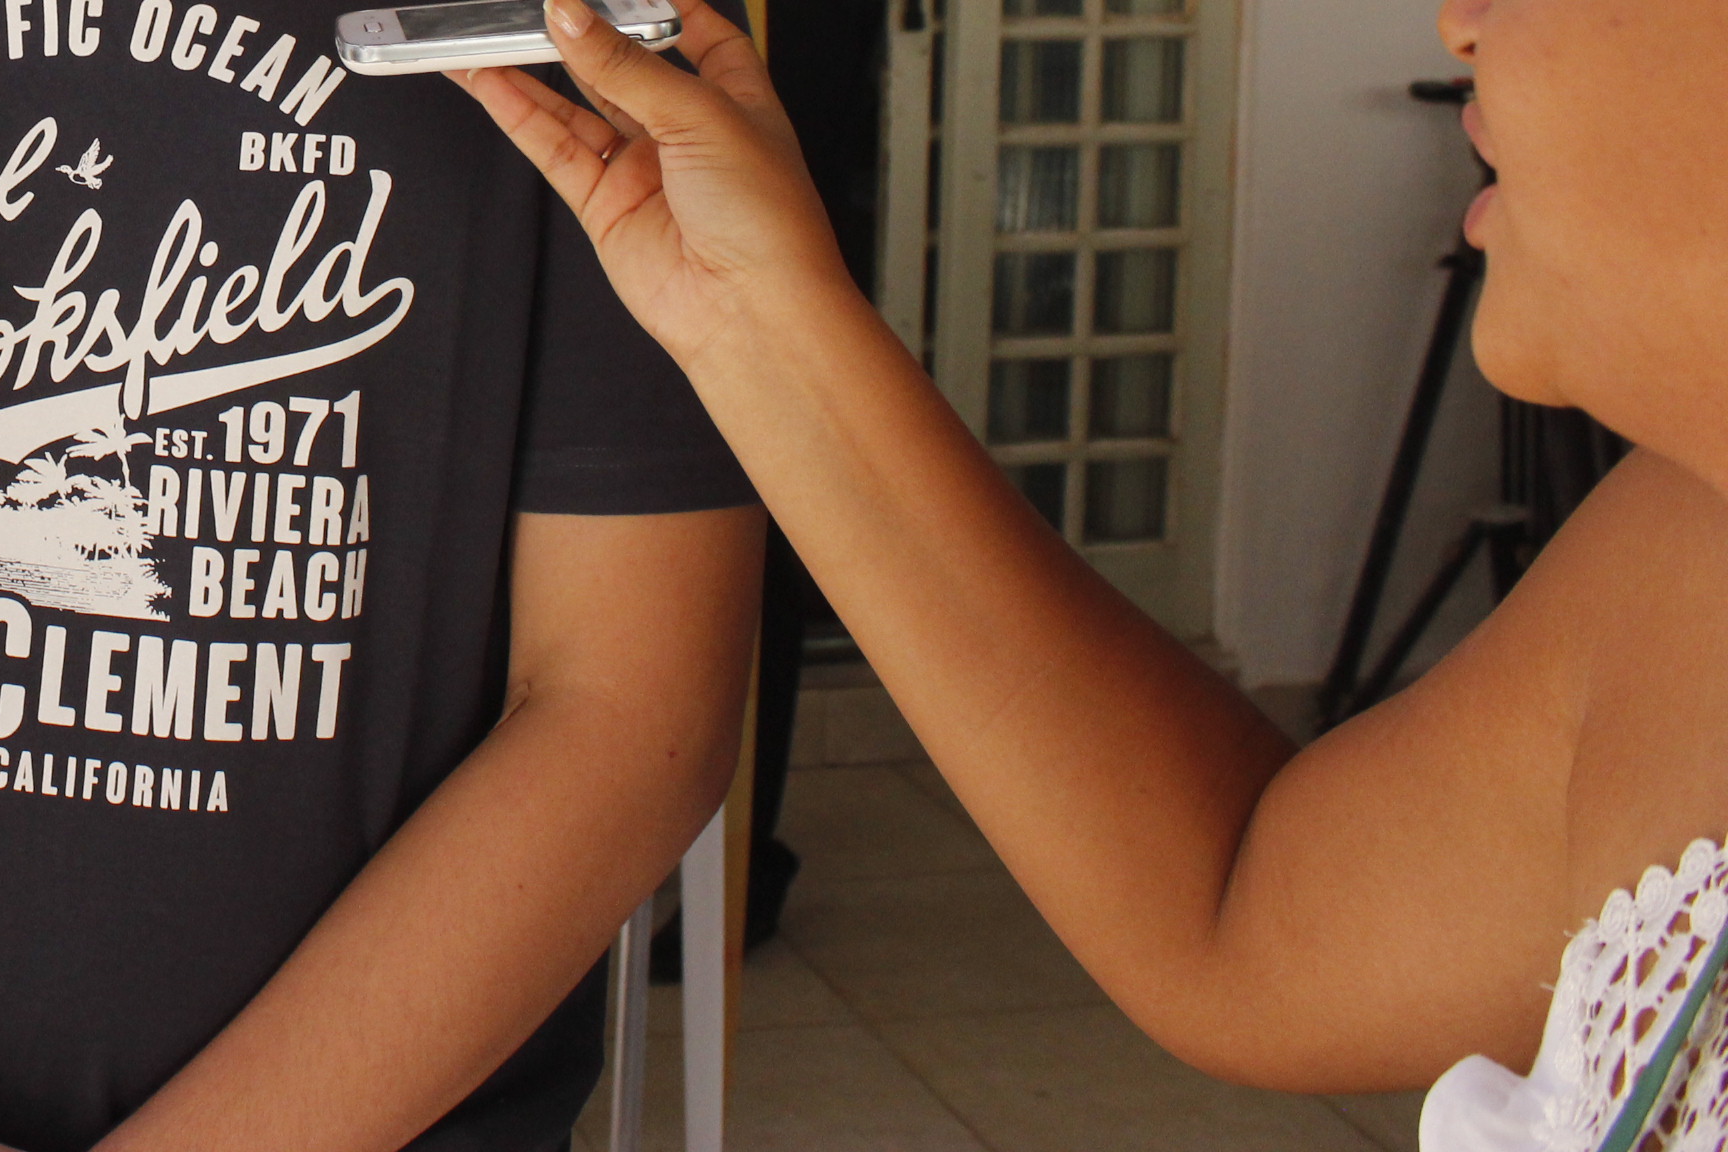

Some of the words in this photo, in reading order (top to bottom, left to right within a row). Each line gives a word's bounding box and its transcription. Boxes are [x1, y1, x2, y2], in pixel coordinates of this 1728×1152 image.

[238, 131, 356, 176] BKFD
[154, 427, 214, 461] EST.
[218, 390, 361, 468] 1971
[147, 464, 369, 546] RIVIERA
[188, 545, 367, 622] BEACH
